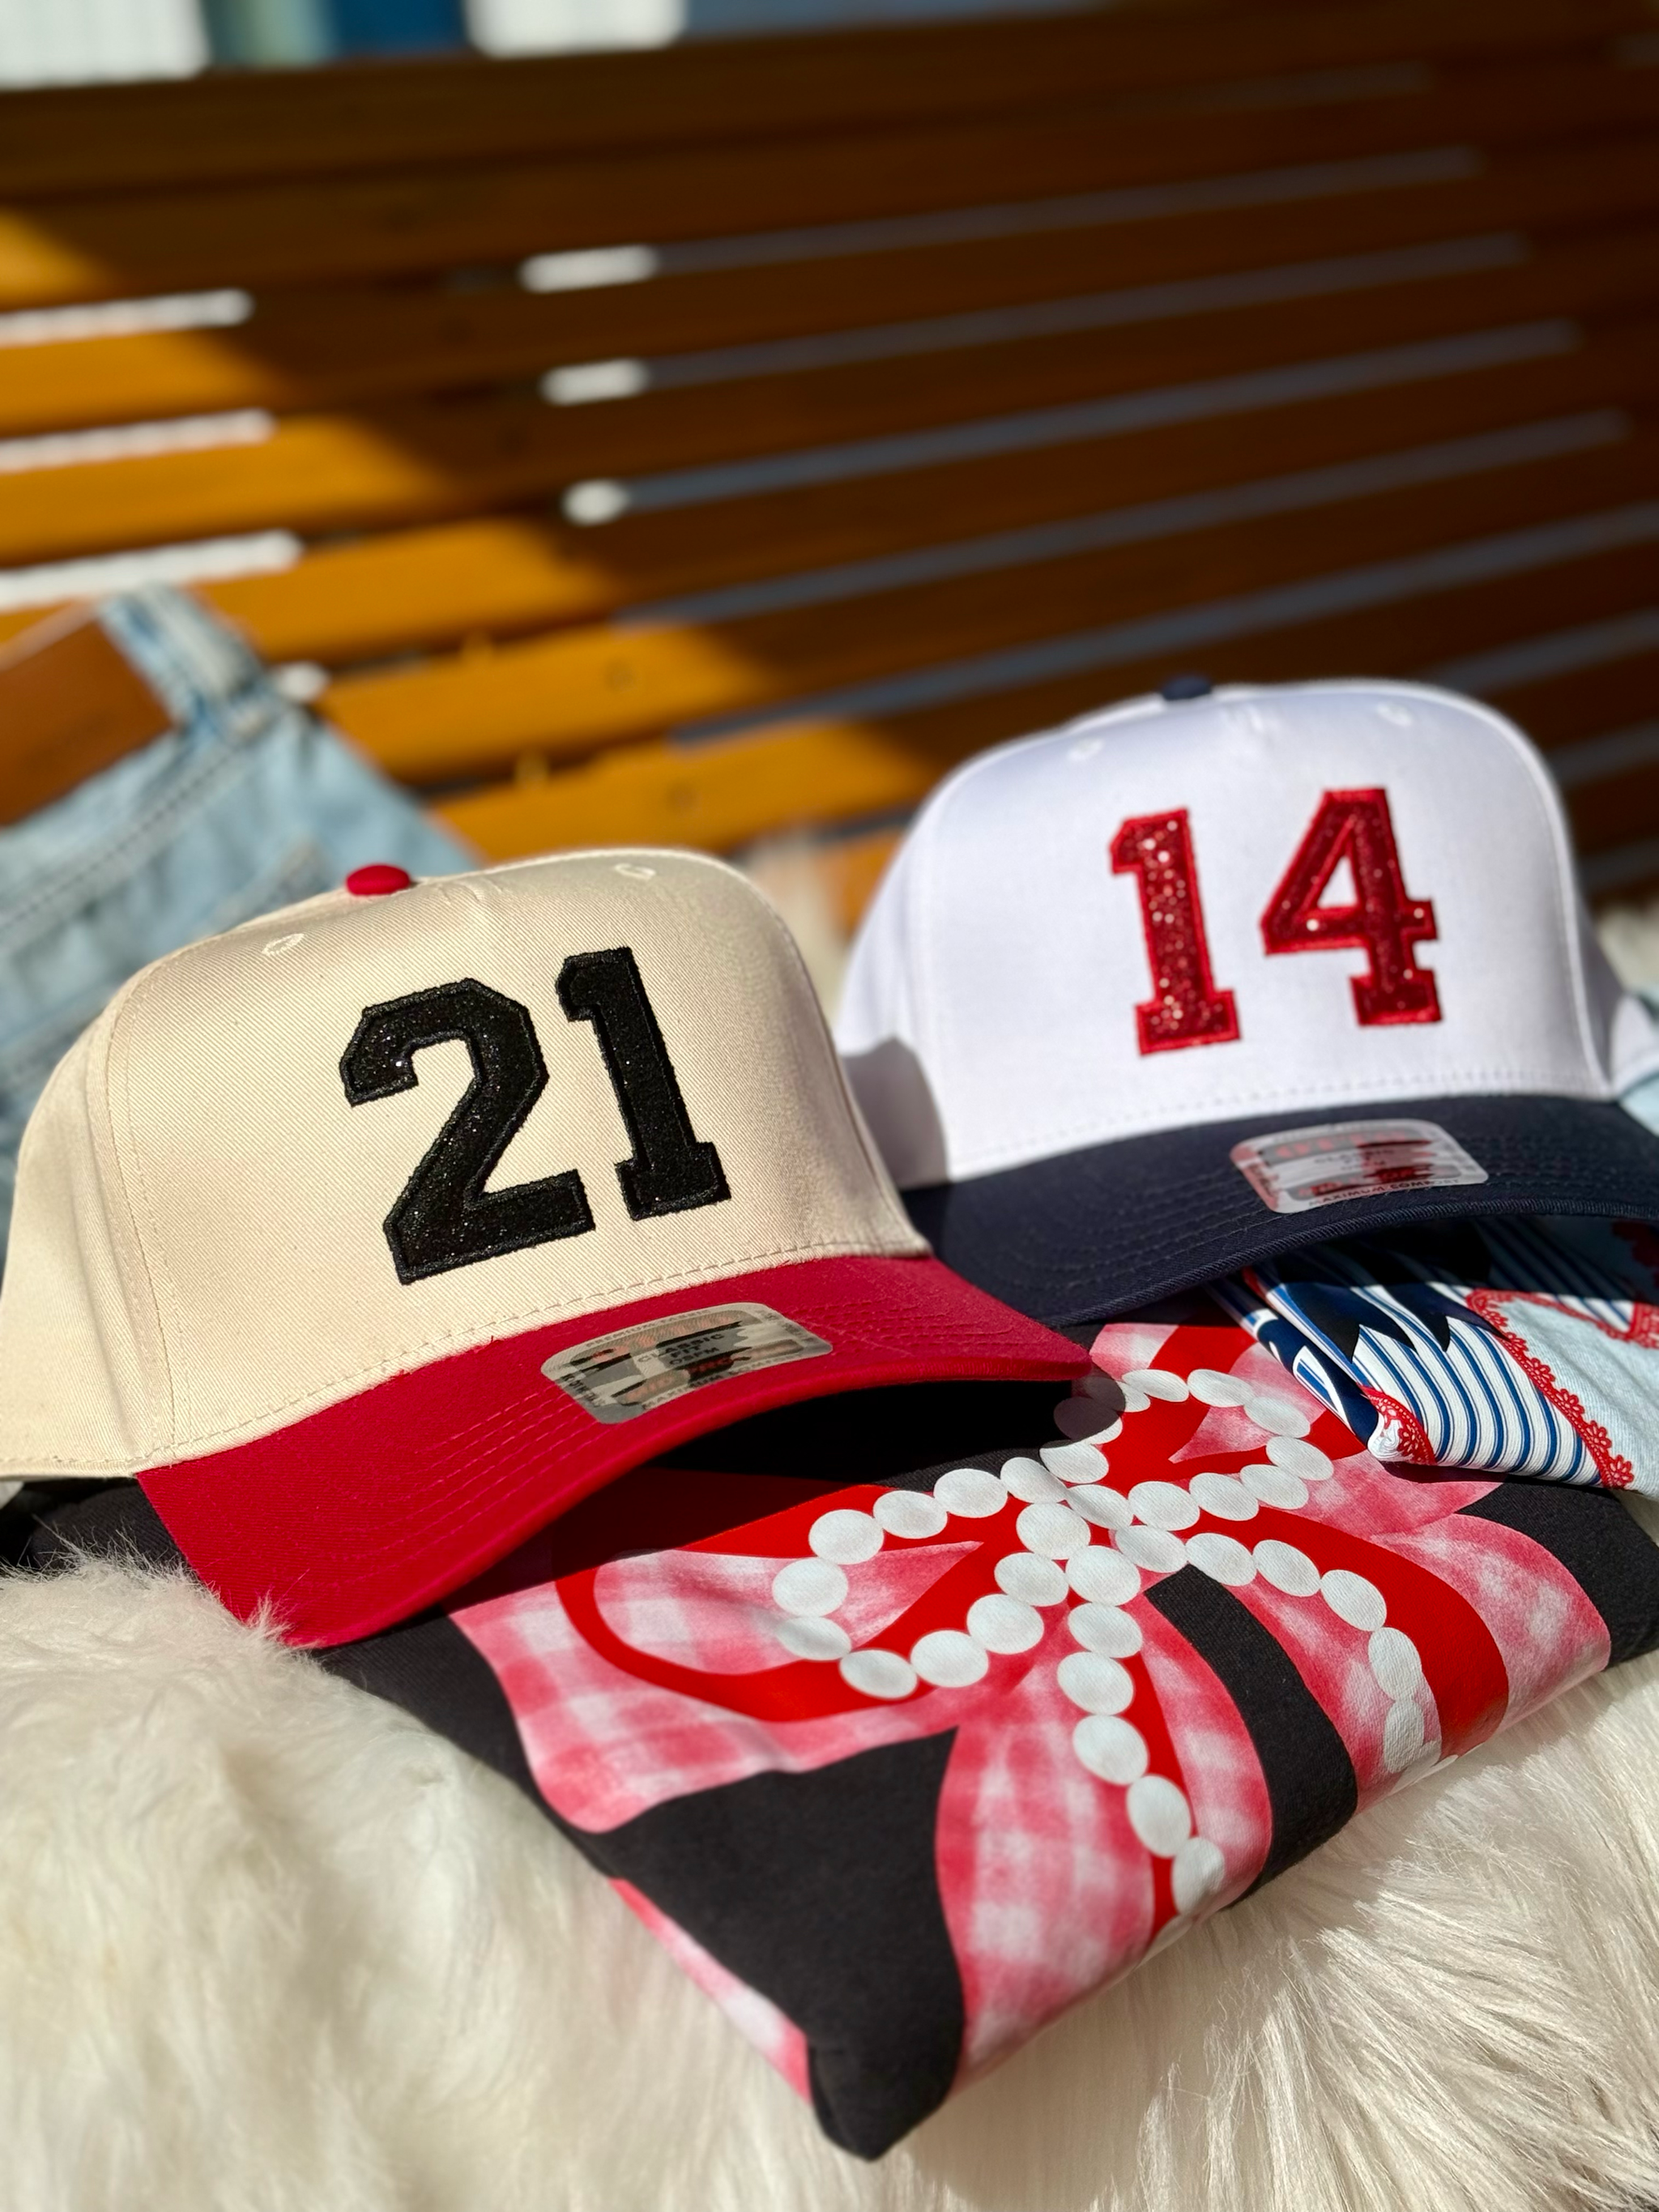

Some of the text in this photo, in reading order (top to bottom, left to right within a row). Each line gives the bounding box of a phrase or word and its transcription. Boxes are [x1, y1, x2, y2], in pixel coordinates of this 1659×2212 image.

[1108, 787, 1443, 1056] 14
[339, 946, 731, 1286] 21
[1308, 1184, 1386, 1207] MAXIMUM
[1388, 1178, 1461, 1192] COMFORT
[638, 1332, 726, 1362] CLASSIC
[668, 1346, 720, 1366] OSFM
[669, 1345, 702, 1358] FIT
[642, 1373, 725, 1411] MAXIMUM
